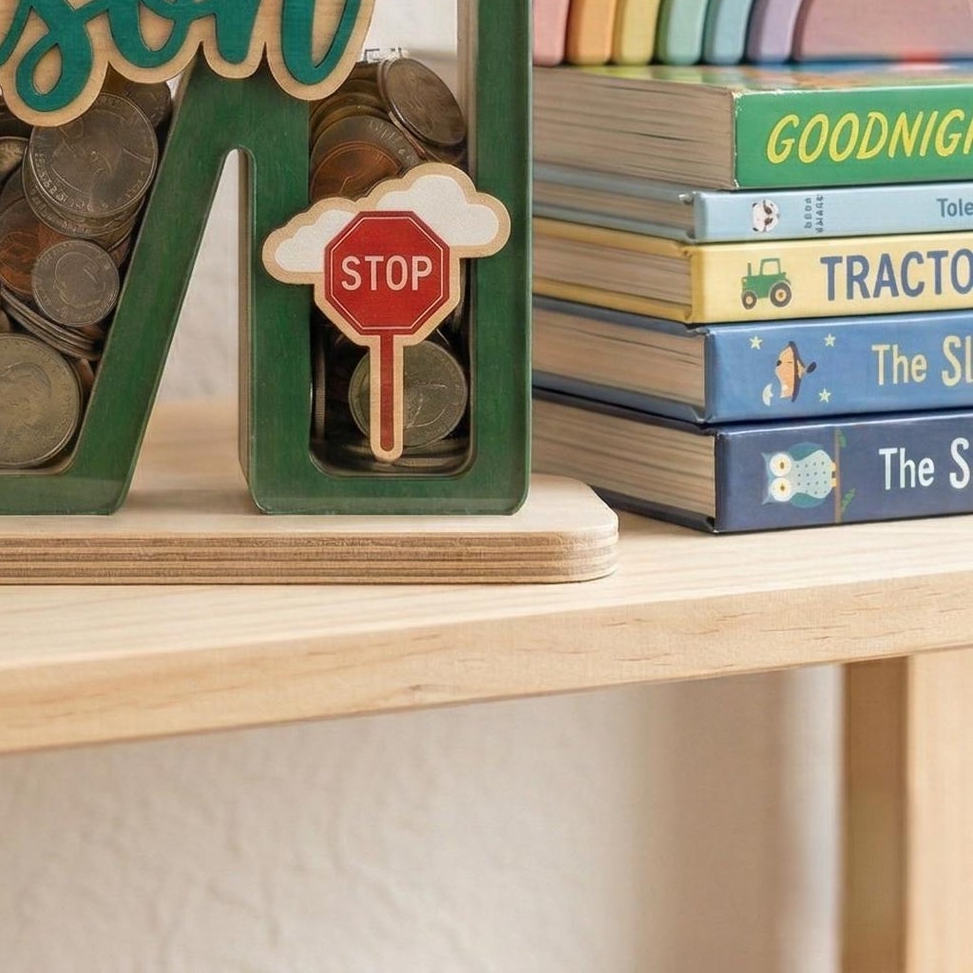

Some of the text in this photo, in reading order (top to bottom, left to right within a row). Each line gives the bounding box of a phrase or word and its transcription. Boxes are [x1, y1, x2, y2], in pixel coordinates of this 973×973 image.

[341, 255, 433, 291] STOP
[820, 248, 973, 301] TRACTO
[871, 344, 927, 386] The
[878, 437, 971, 491] The S
